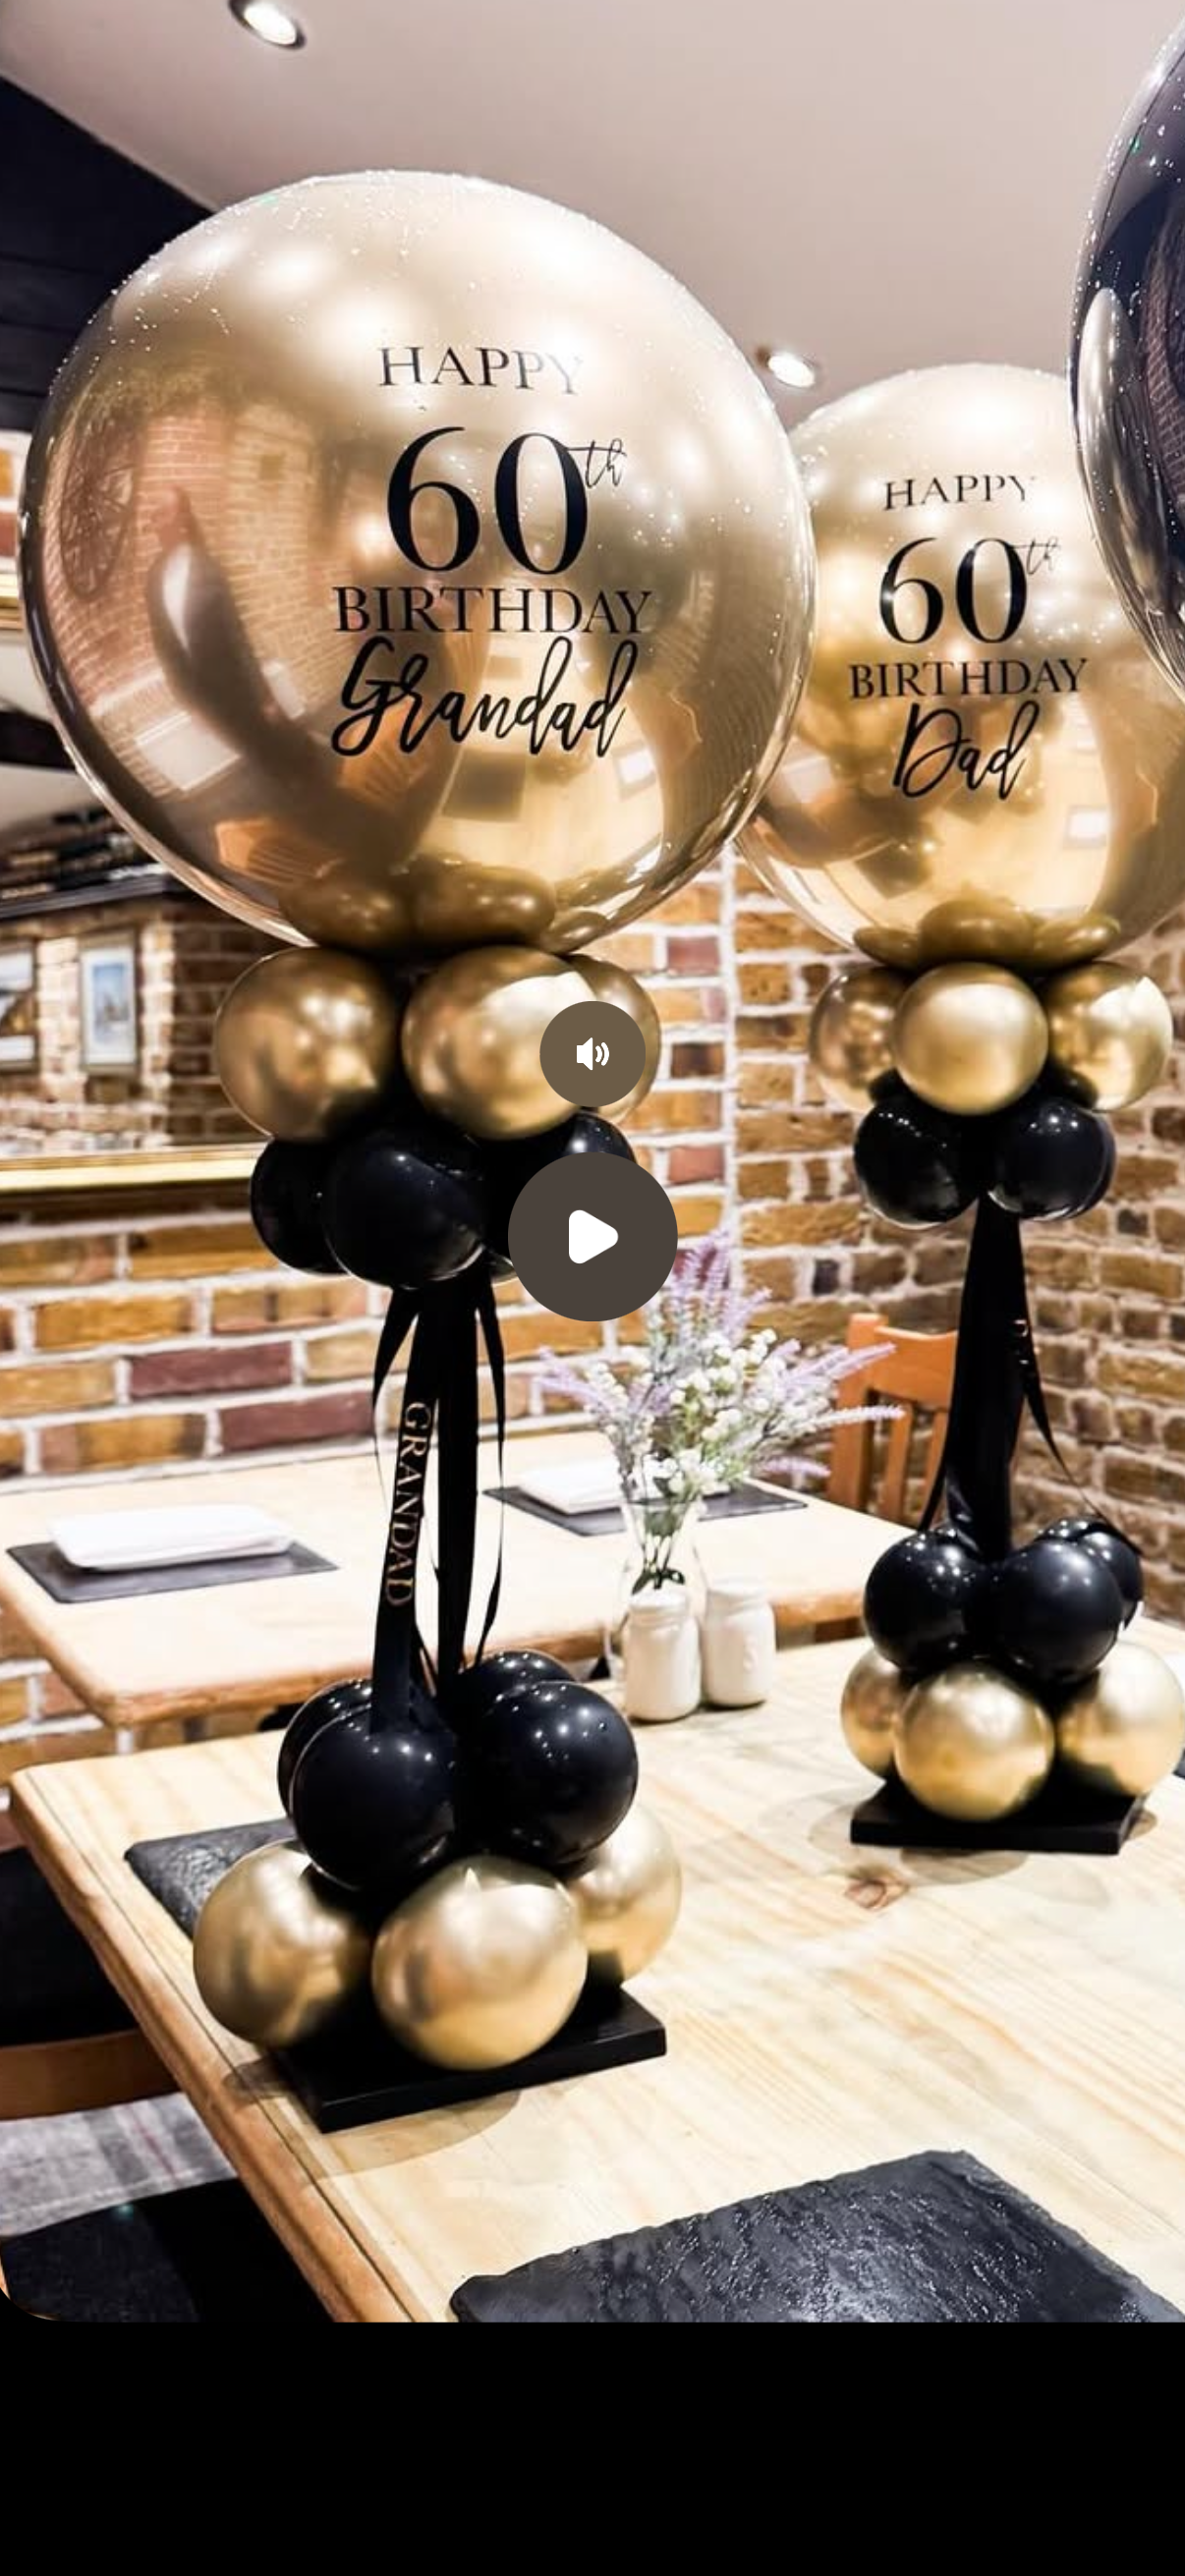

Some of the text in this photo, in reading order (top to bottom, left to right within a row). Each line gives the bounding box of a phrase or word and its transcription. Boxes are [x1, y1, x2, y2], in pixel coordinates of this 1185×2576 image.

[378, 346, 584, 395] HAPPY
[884, 475, 1036, 511] HAPPY
[332, 587, 652, 634] BIRTHDAY
[331, 636, 639, 757] Grandad
[848, 657, 1088, 700] BIRTHDAY
[892, 700, 1041, 801] Dad
[384, 1401, 431, 1607] GRANDAD
